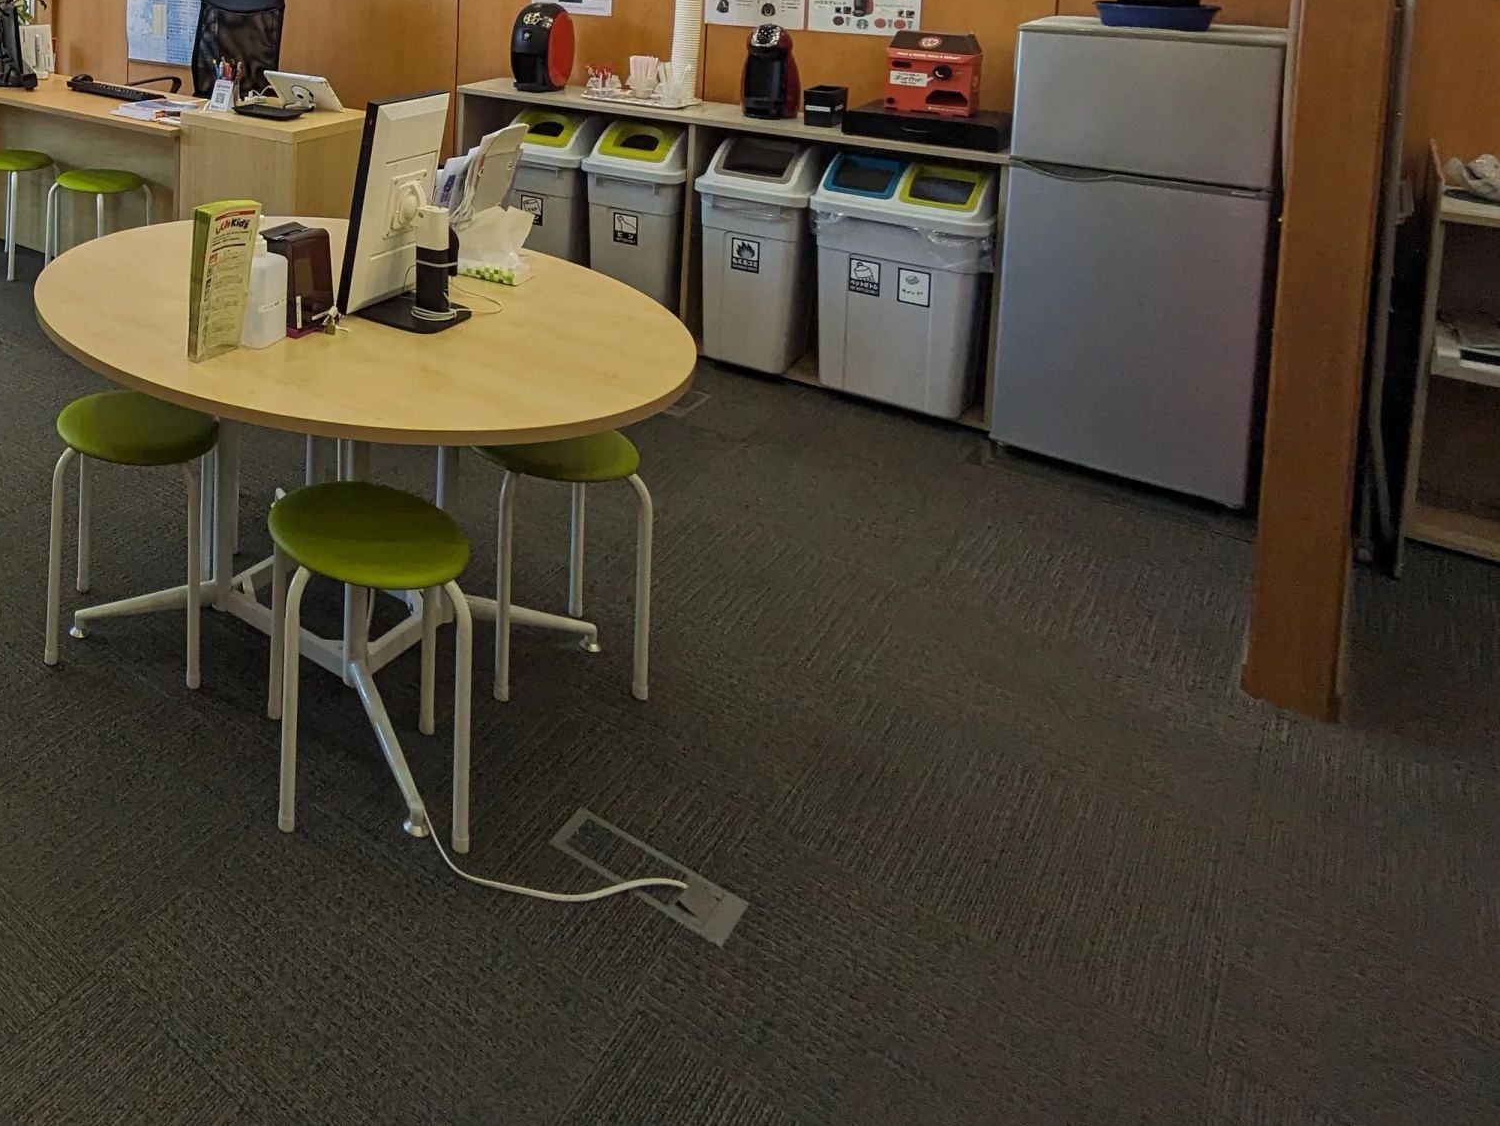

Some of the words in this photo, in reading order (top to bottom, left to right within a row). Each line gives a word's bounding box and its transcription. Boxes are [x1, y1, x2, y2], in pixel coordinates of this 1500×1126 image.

[849, 279, 879, 290] ペットボトル
